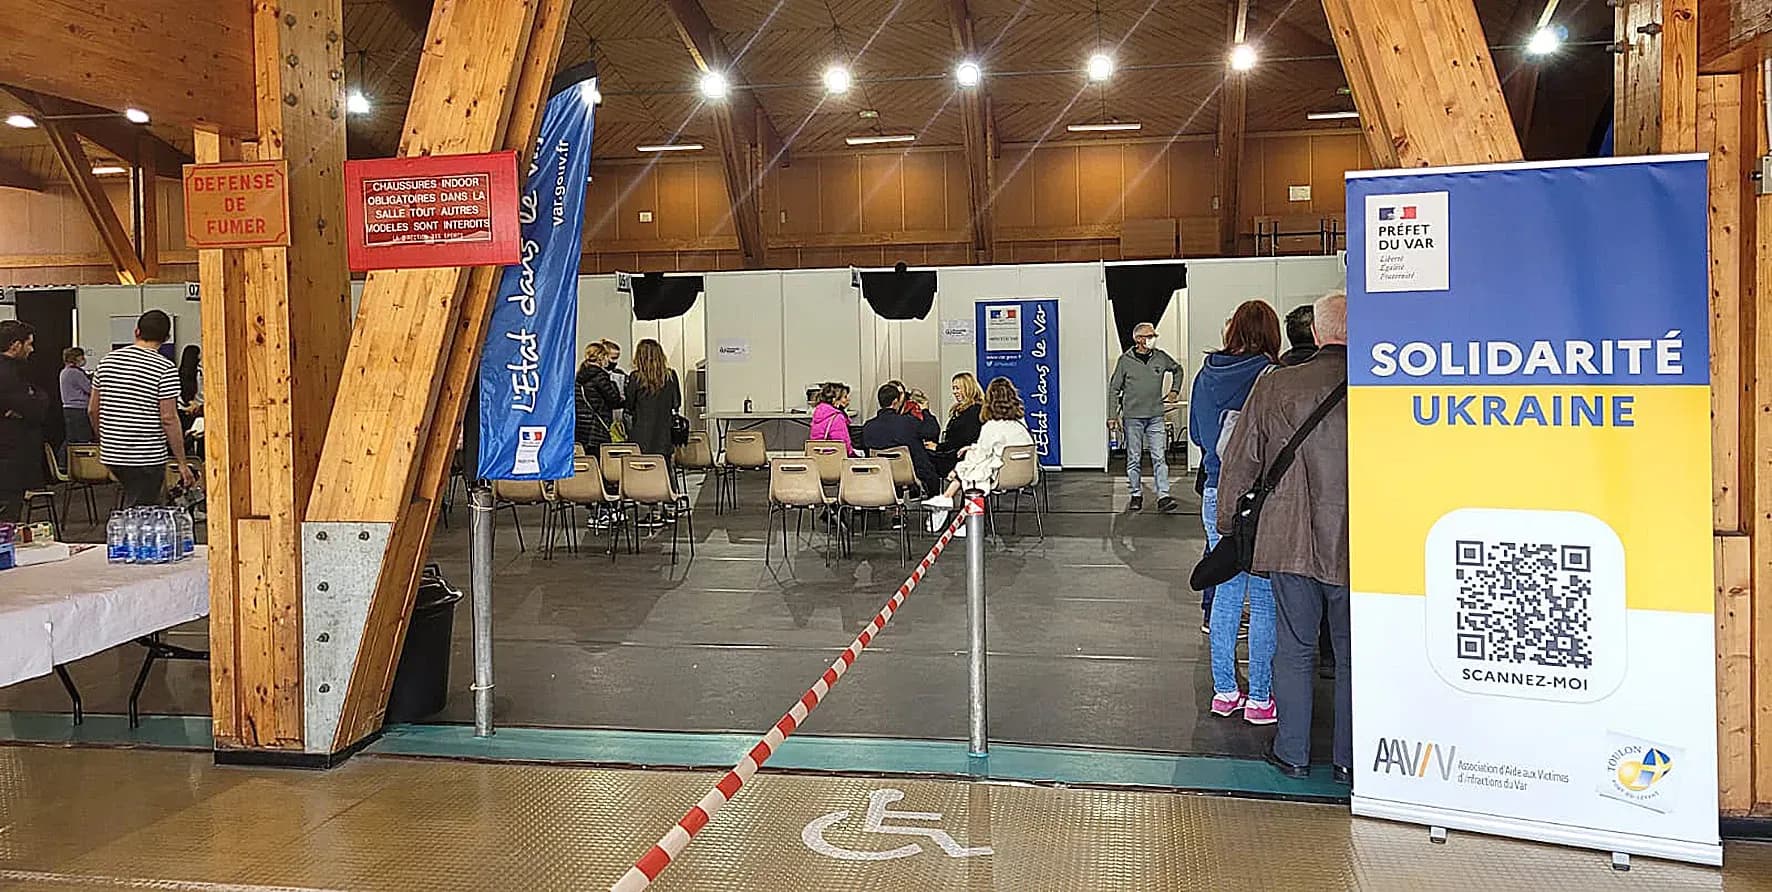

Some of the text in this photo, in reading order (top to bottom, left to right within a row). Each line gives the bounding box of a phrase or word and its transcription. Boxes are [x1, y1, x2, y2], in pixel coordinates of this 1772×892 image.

[193, 173, 275, 192] DEFENSE
[372, 177, 480, 192] CHAUSSURES INDOOR
[551, 139, 569, 226] var.gouv.fr
[224, 196, 246, 213] DE
[367, 191, 486, 206] OBLIGATOIRES DANS LA
[375, 205, 480, 219] SALLE TOUT AUTRES
[207, 218, 266, 235] FUMER
[413, 220, 439, 231] SONT
[443, 218, 490, 229] INTERDITS
[1378, 222, 1431, 237] PRÉFET
[1379, 238, 1434, 250] DU VAR
[507, 238, 540, 316] dans
[189, 283, 200, 297] 07
[1033, 304, 1047, 335] Var
[1031, 338, 1047, 359] le
[1370, 329, 1684, 377] SOLIDARITÉ
[1031, 363, 1050, 405] dans
[1411, 394, 1635, 427] UKRAINE
[1462, 668, 1588, 691] SCANNEZ-MOI
[1607, 745, 1642, 772] TOULON
[1458, 760, 1569, 784] Association d'Aide aux Victimes
[1503, 778, 1514, 789] du
[1514, 779, 1528, 791] Var
